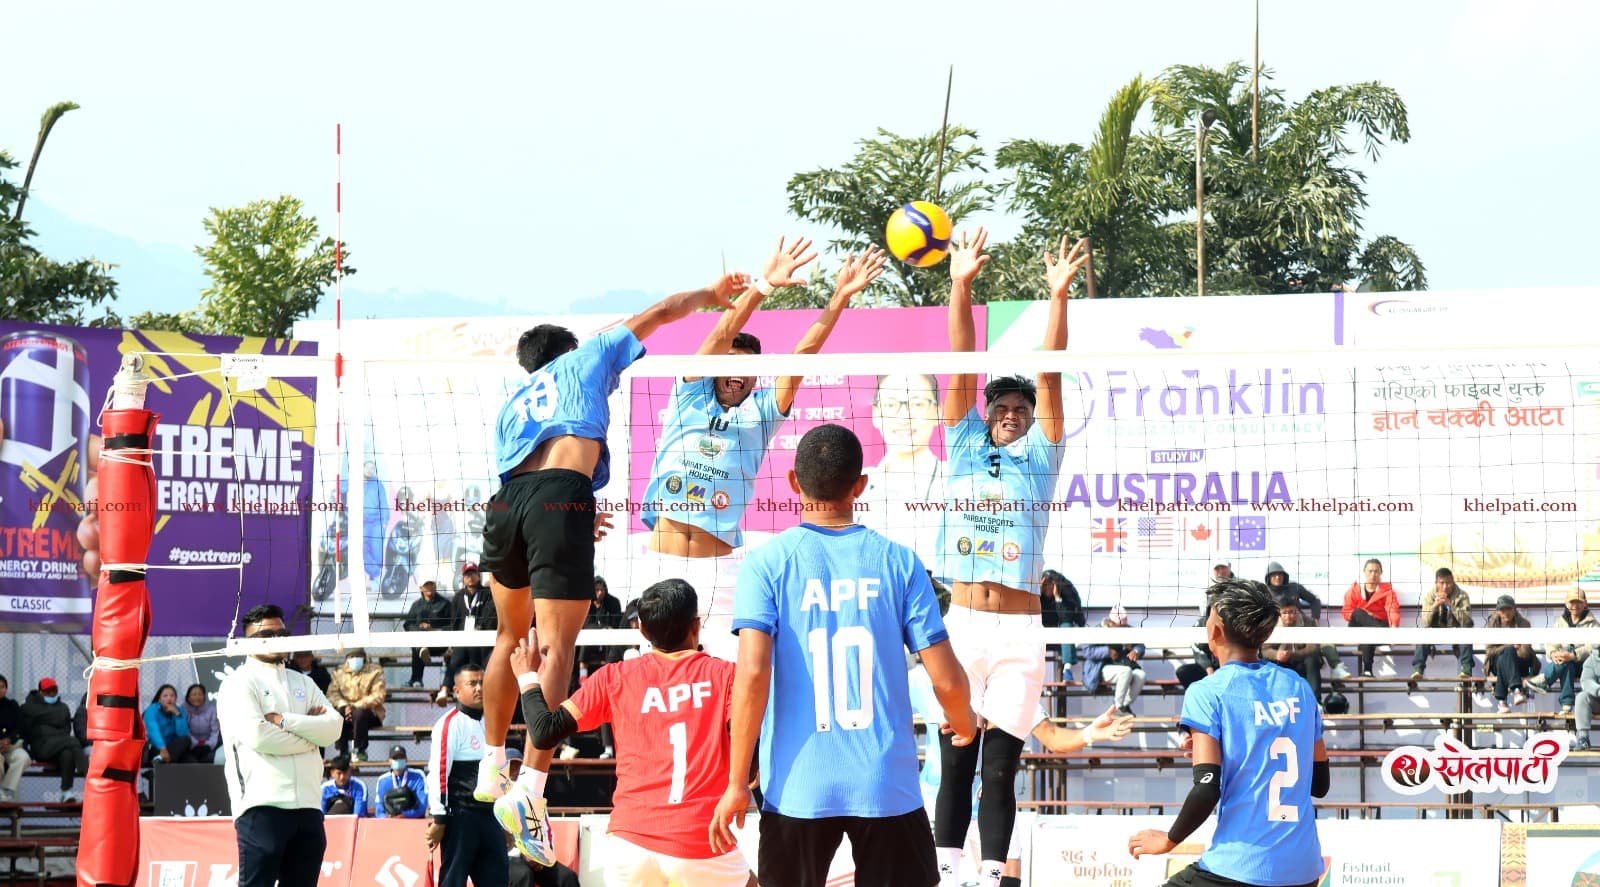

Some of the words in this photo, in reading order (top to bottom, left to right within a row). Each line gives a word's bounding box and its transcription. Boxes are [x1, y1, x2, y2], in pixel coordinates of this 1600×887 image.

[1107, 368, 1324, 418] Franklin
[1373, 381, 1436, 401] गरिएको
[1445, 383, 1503, 400] फाइबर
[1372, 410, 1419, 432] ज्ञान
[1427, 400, 1496, 428] चक्की
[1504, 407, 1565, 427] आटा
[155, 424, 303, 482] TREME
[1154, 450, 1188, 463] STUDY
[1189, 449, 1201, 462] IN
[688, 470, 713, 482] HOUSE
[703, 465, 729, 479] SPORTS
[988, 454, 1001, 478] 5
[157, 480, 219, 512] ERGY
[227, 483, 300, 516] DRINK
[1065, 471, 1292, 508] AUSTRALIA
[963, 513, 987, 524] PARBAT
[987, 518, 1014, 528] SPORTS
[975, 525, 1000, 534] HOUSE
[0, 560, 38, 572] NERGY
[41, 561, 78, 574] DRINK
[169, 547, 252, 565] #goxtreme
[10, 598, 52, 610] CLASSIC
[800, 578, 881, 612] APF
[808, 626, 874, 732] 10
[640, 680, 712, 715] APF
[1254, 698, 1301, 726] APF
[668, 722, 687, 804] 1
[1267, 736, 1299, 822] 2
[1342, 862, 1392, 873] Fishtail
[1342, 873, 1405, 885] Mountain
